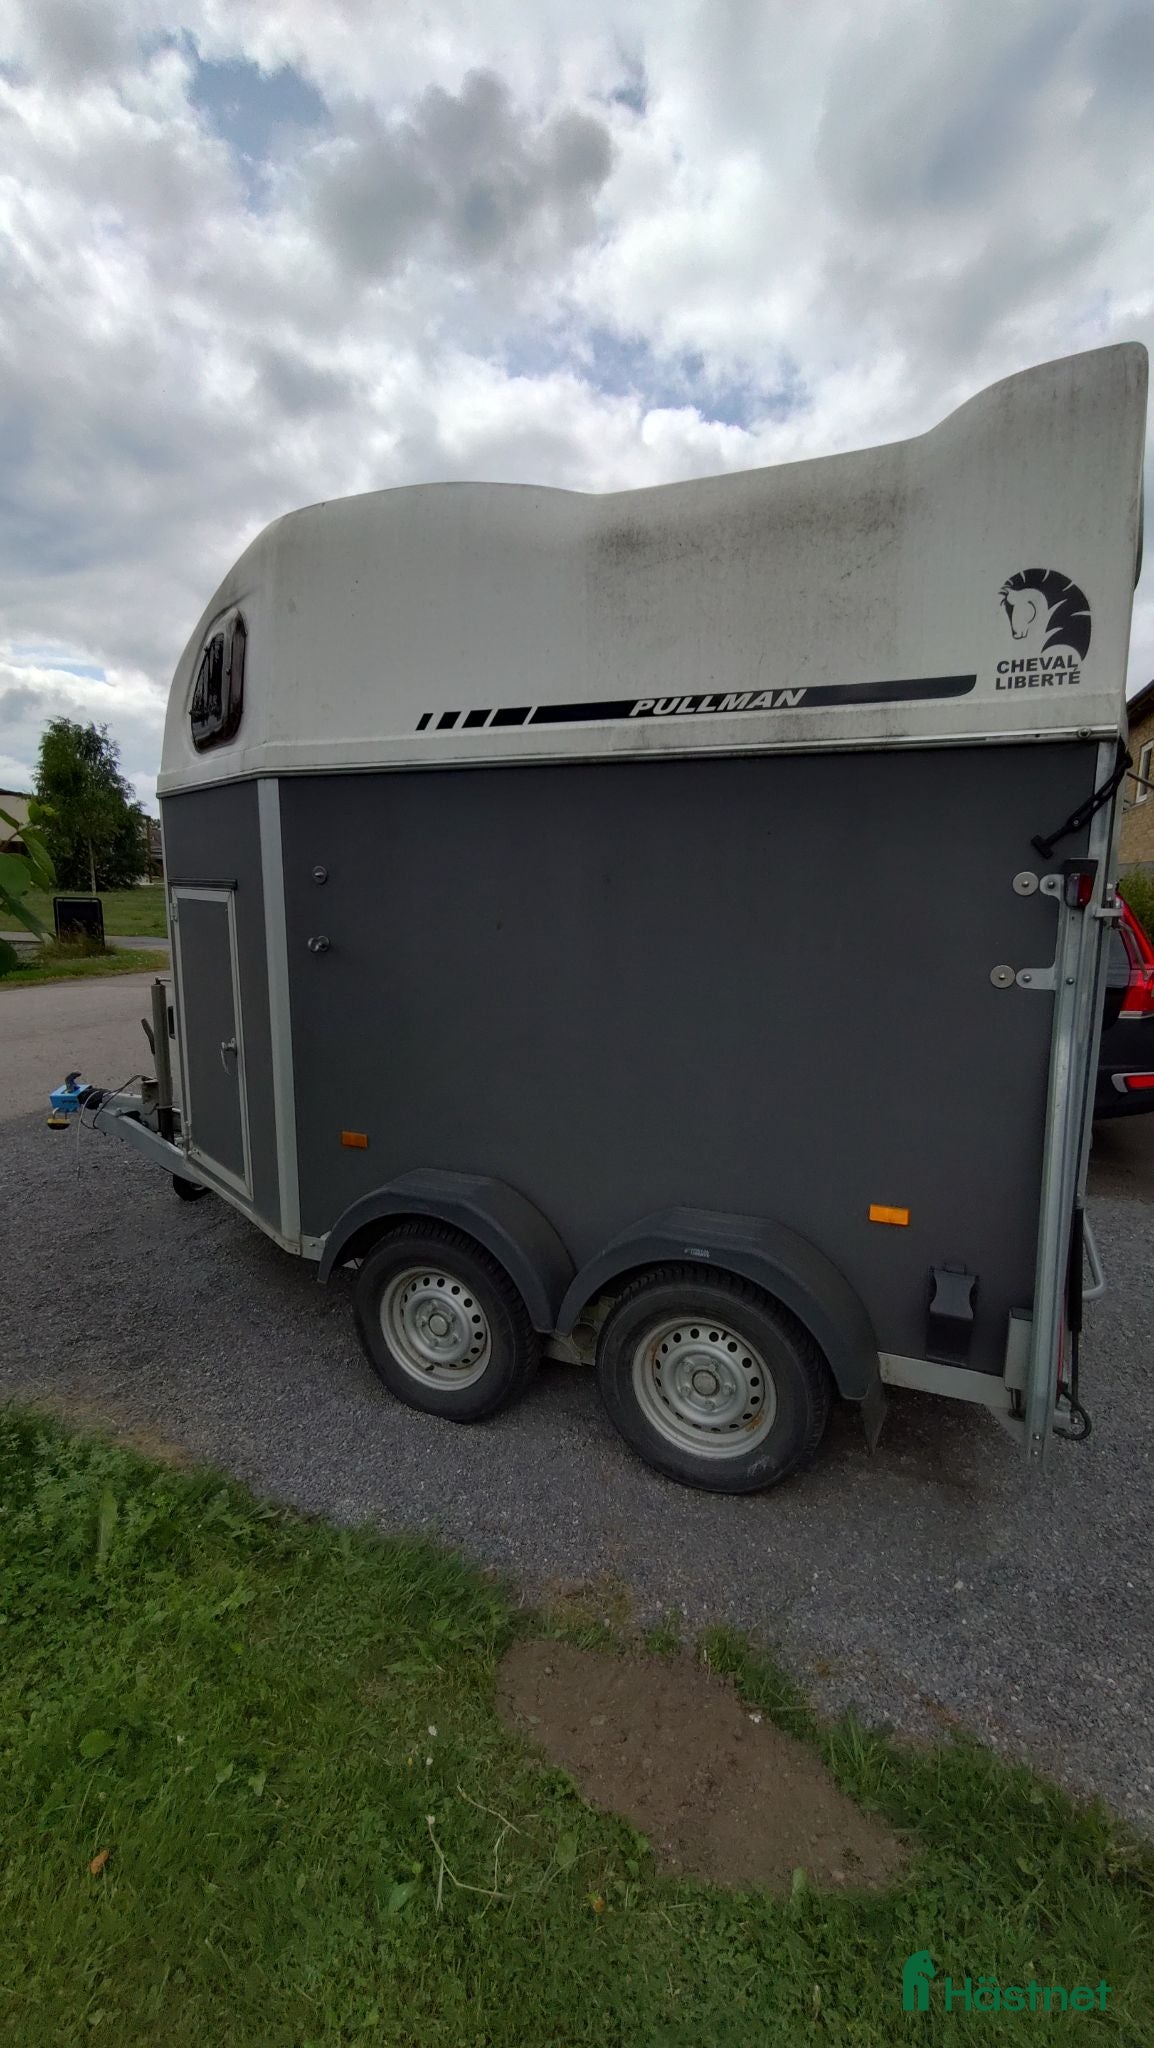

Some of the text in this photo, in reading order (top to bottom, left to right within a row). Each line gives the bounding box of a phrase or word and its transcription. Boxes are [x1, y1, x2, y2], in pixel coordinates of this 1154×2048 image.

[996, 655, 1079, 674] CHEVAL
[995, 668, 1081, 691] LIBERTÉ
[629, 688, 807, 717] PULLMAN
